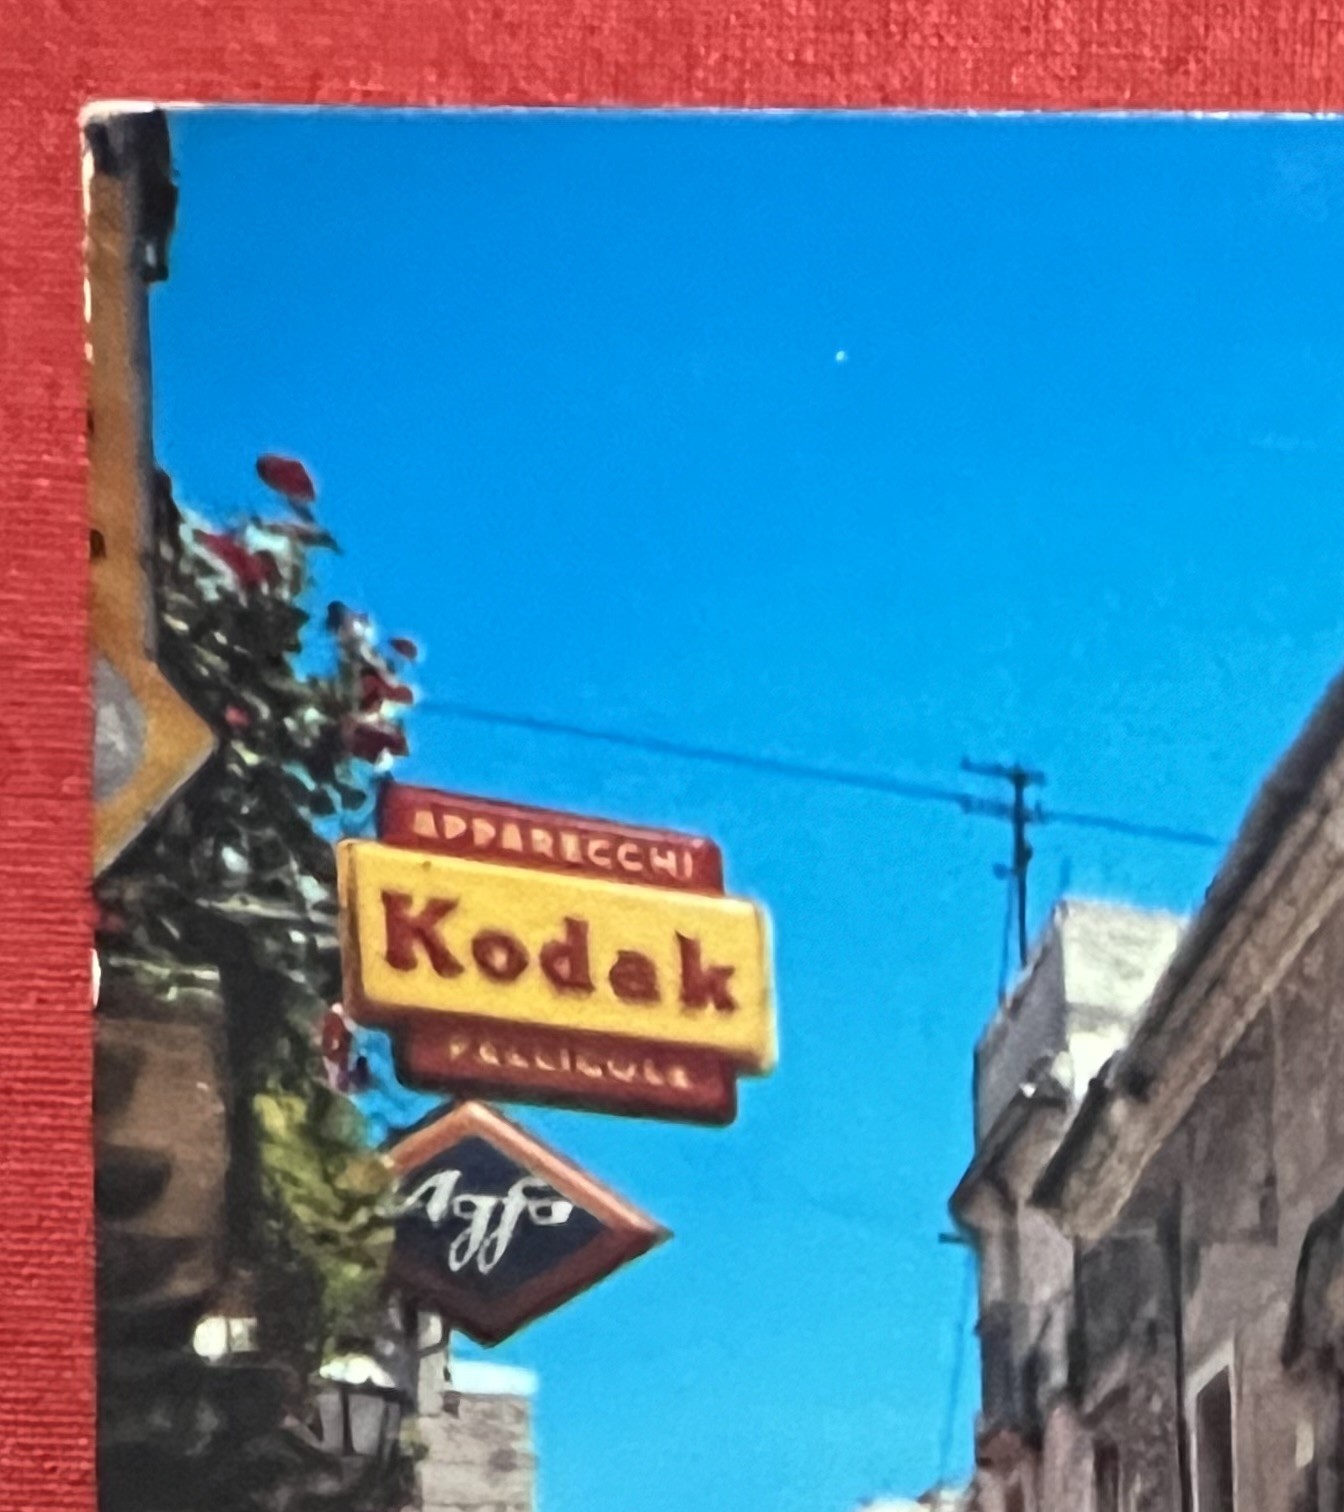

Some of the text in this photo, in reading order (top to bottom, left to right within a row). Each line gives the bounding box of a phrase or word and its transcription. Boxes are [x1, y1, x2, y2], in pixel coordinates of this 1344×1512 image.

[412, 808, 694, 880] APPARECCHI
[381, 888, 740, 1013] Kodak
[388, 1168, 575, 1276] Agfa
